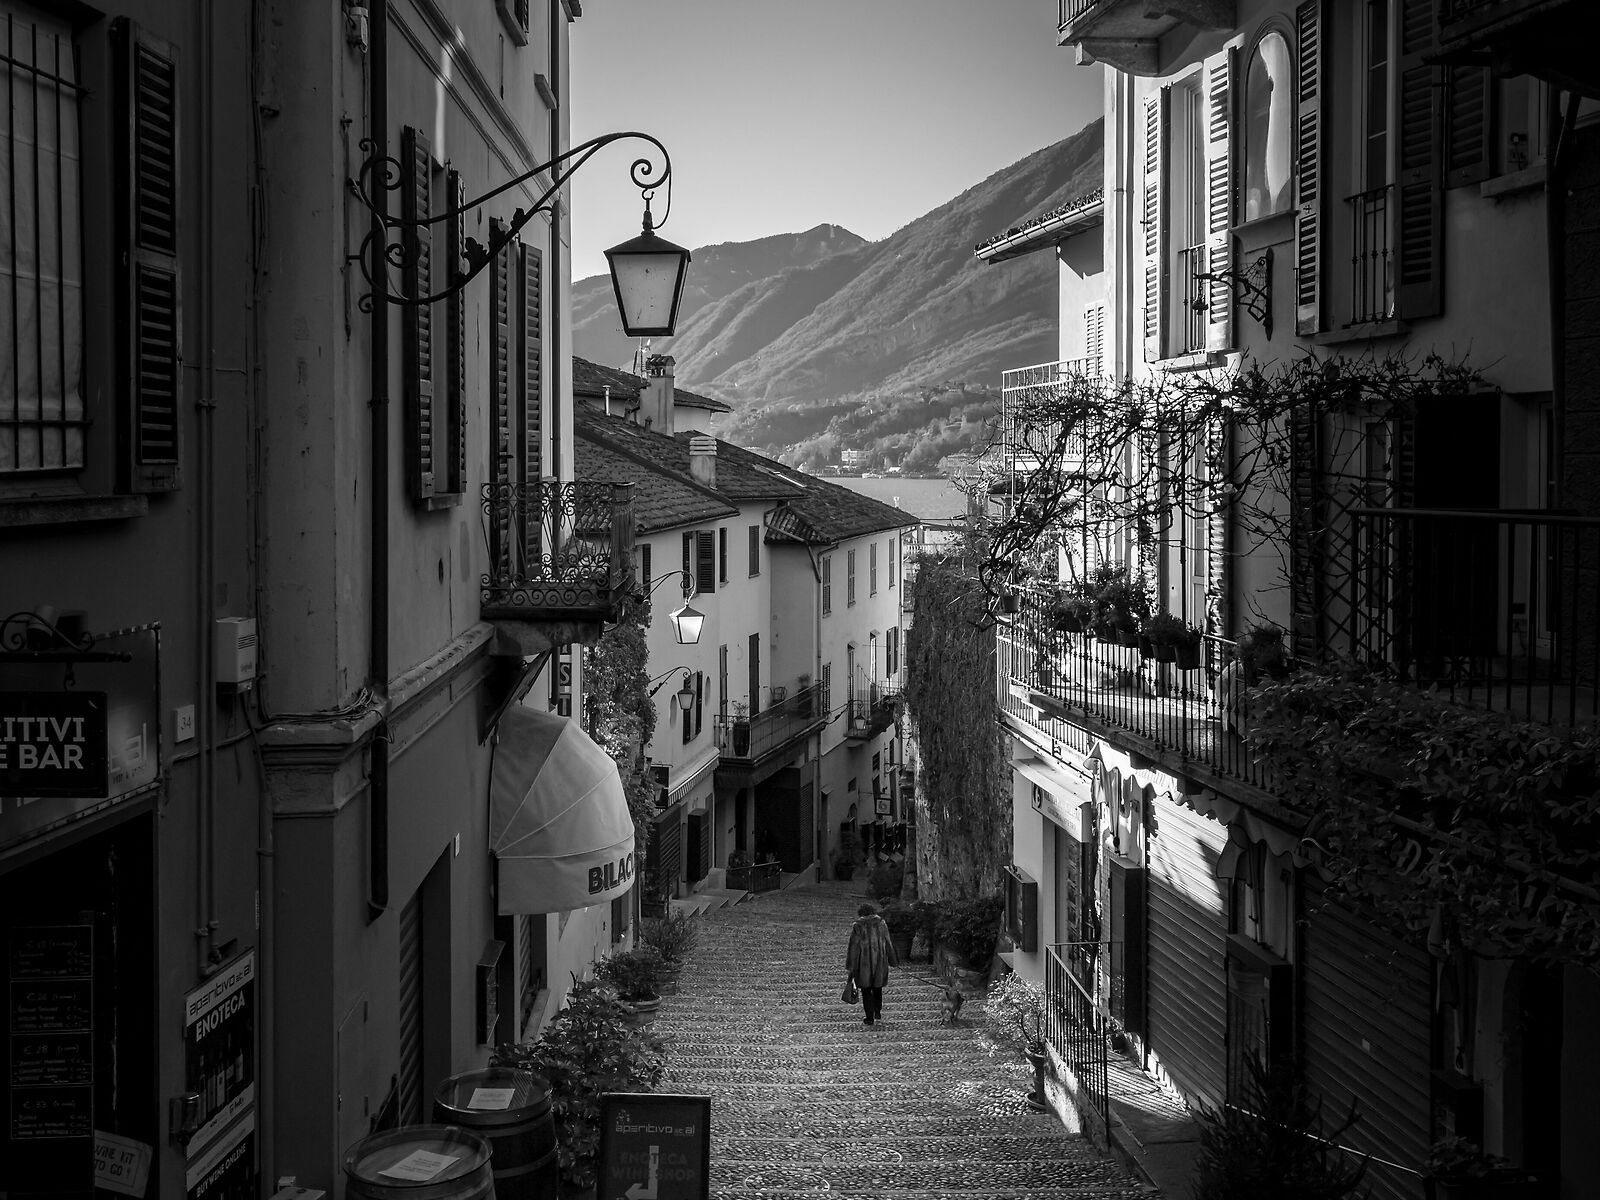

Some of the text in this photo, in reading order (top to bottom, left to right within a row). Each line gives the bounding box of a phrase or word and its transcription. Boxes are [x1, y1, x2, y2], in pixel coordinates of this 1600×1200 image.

[0, 717, 86, 742] ITIVI
[18, 744, 85, 769] BAR
[588, 853, 634, 895] BILAC
[195, 989, 246, 1042] ENOTECA
[615, 1123, 673, 1135] aperitivo
[196, 1143, 247, 1198] BUY WINE ONLINE
